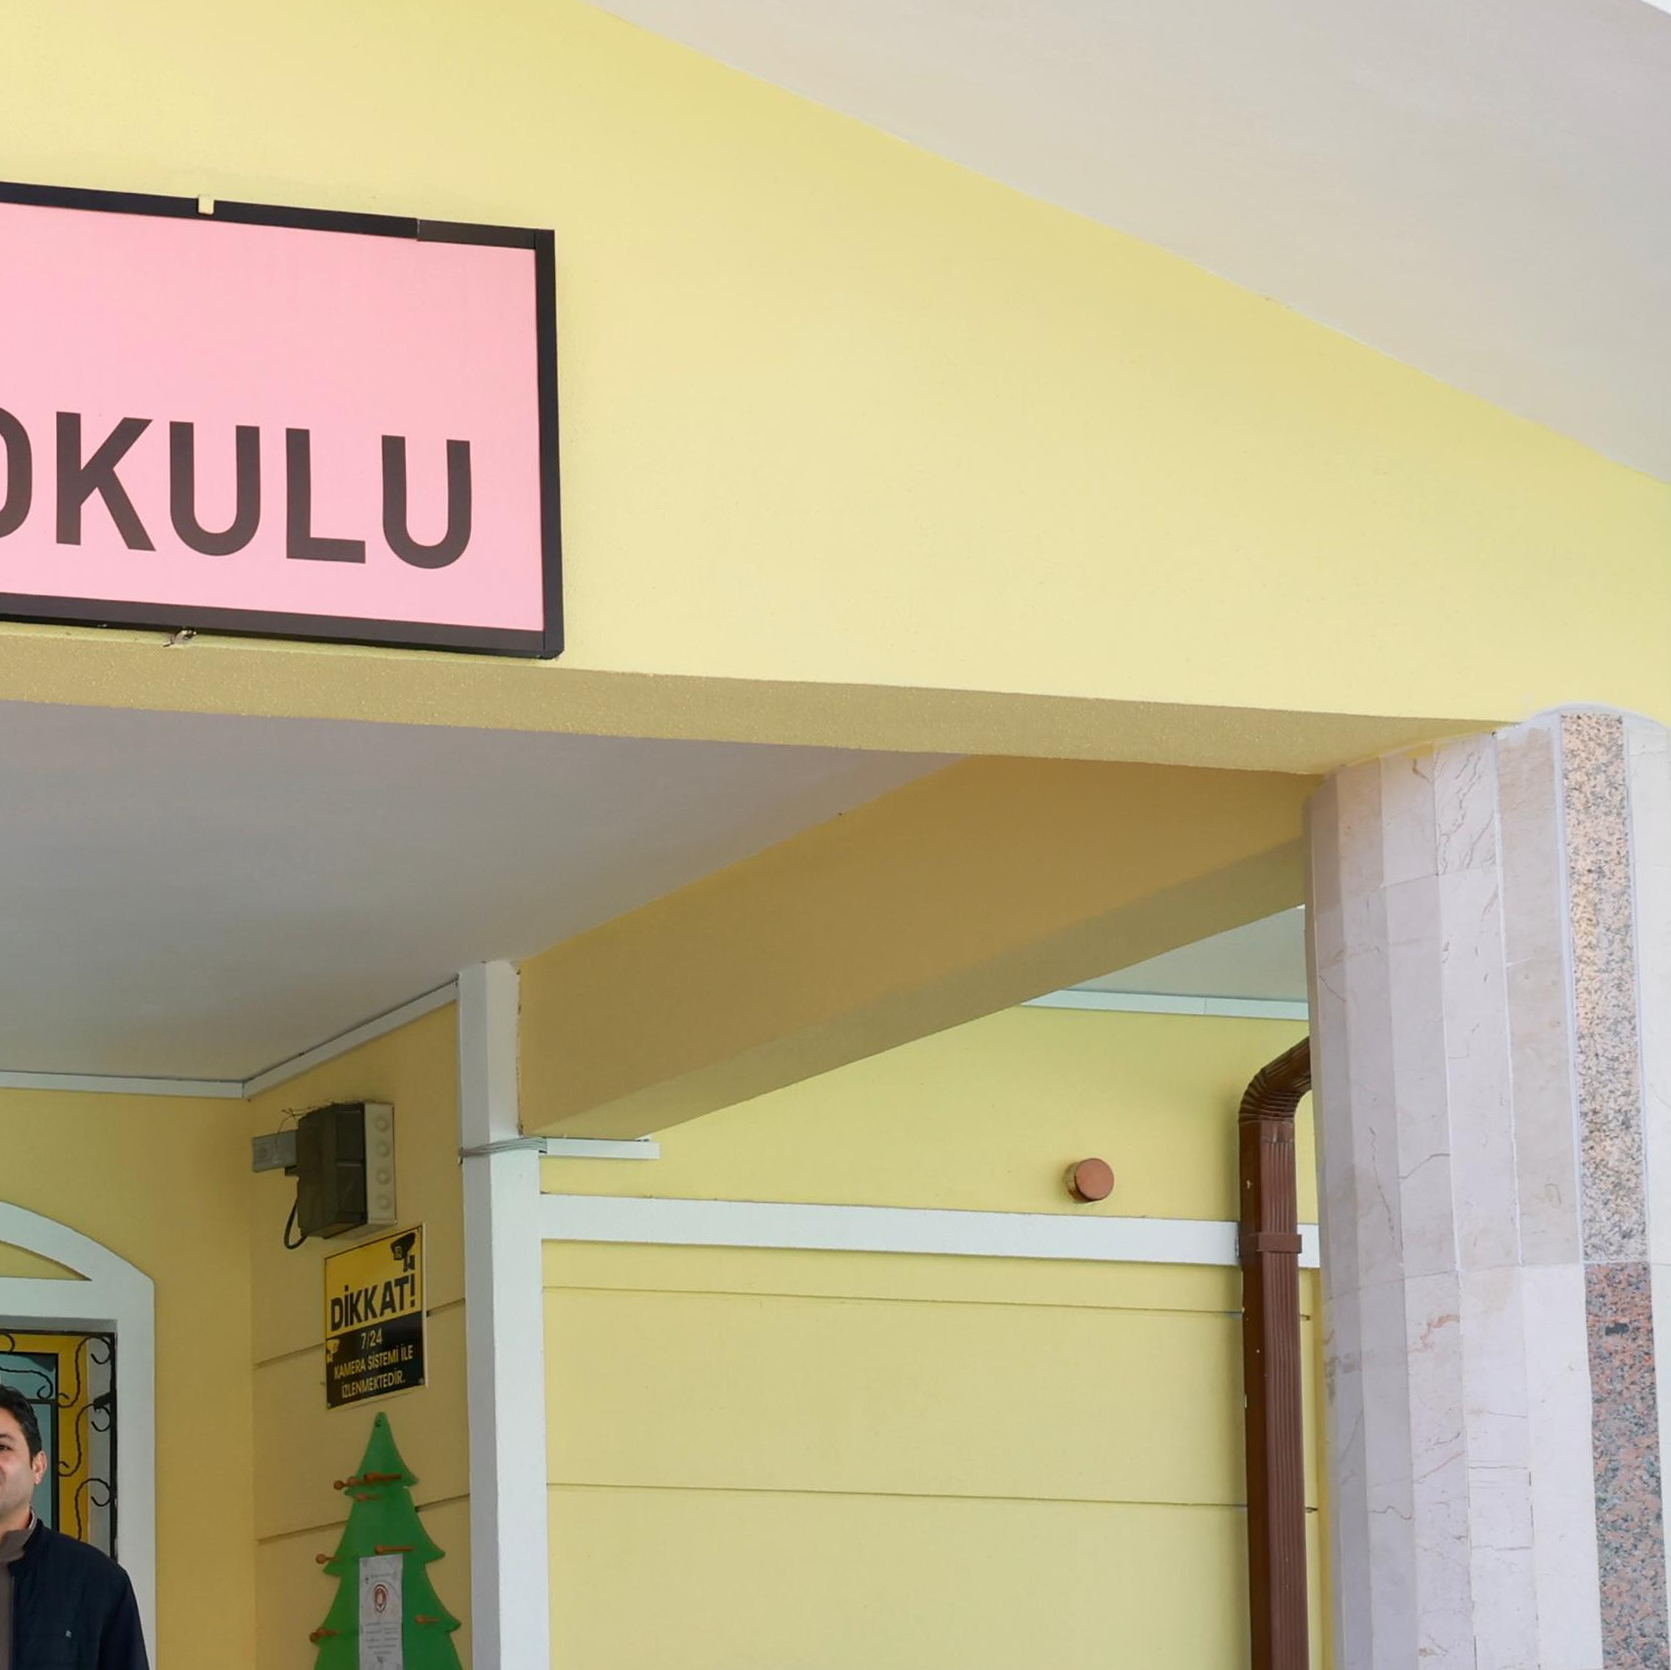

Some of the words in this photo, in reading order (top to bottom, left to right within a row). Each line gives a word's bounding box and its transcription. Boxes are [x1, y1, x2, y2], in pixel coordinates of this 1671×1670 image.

[331, 1273, 415, 1331] DİKKAT!
[361, 1328, 383, 1350] 7/24
[334, 1359, 366, 1379] KAMERA
[367, 1345, 399, 1370] SİSTEMİ
[401, 1344, 413, 1360] İLE
[341, 1368, 405, 1398] İZLENMEKTEDİR.
